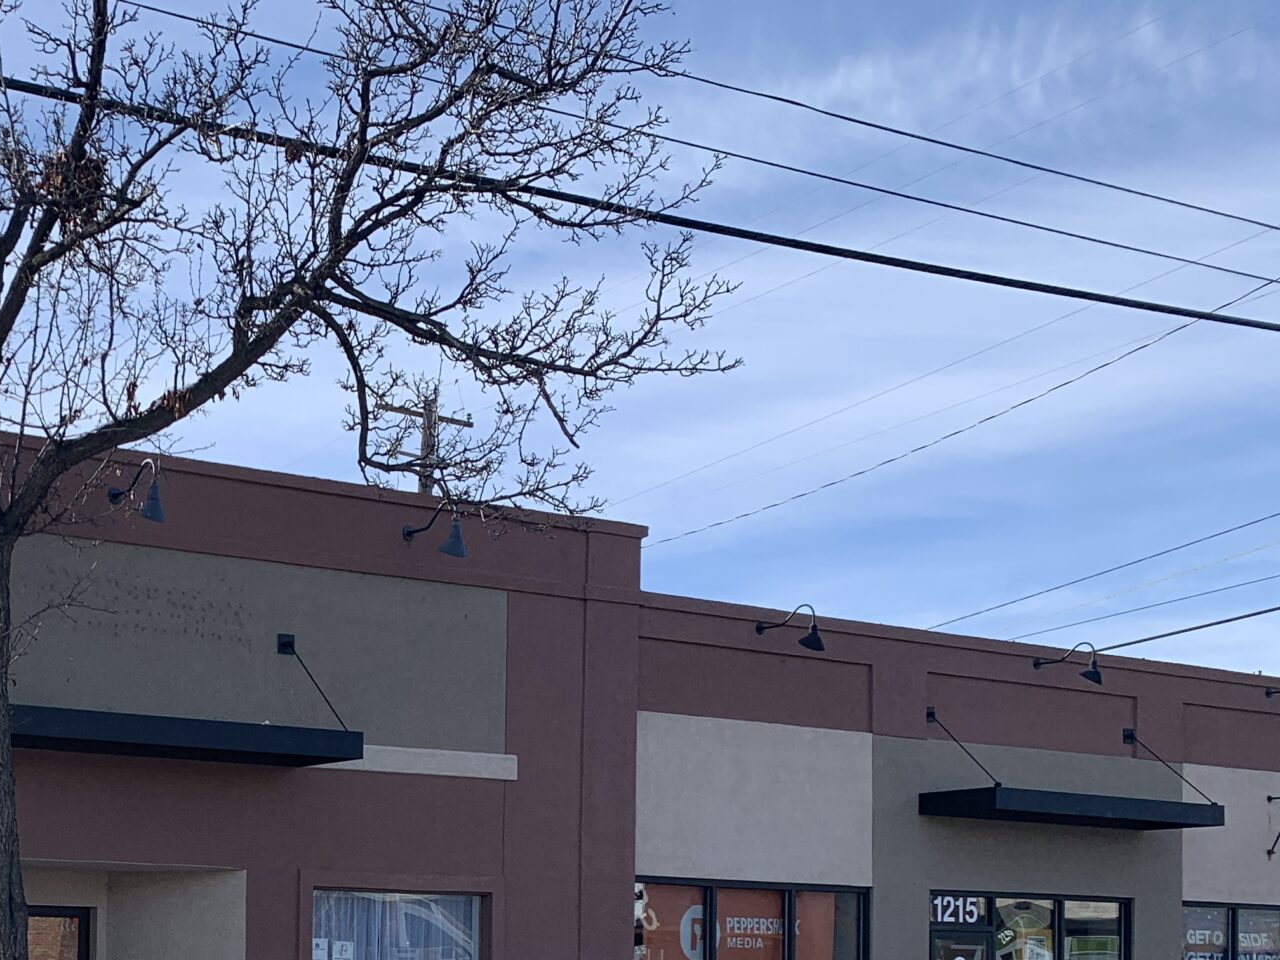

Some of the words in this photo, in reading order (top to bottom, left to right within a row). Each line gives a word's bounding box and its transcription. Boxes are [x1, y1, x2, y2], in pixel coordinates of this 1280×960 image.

[933, 896, 978, 923] 1215
[726, 917, 801, 935] PEPPERSHK
[727, 936, 764, 949] MEDIA
[1186, 929, 1211, 945] GET
